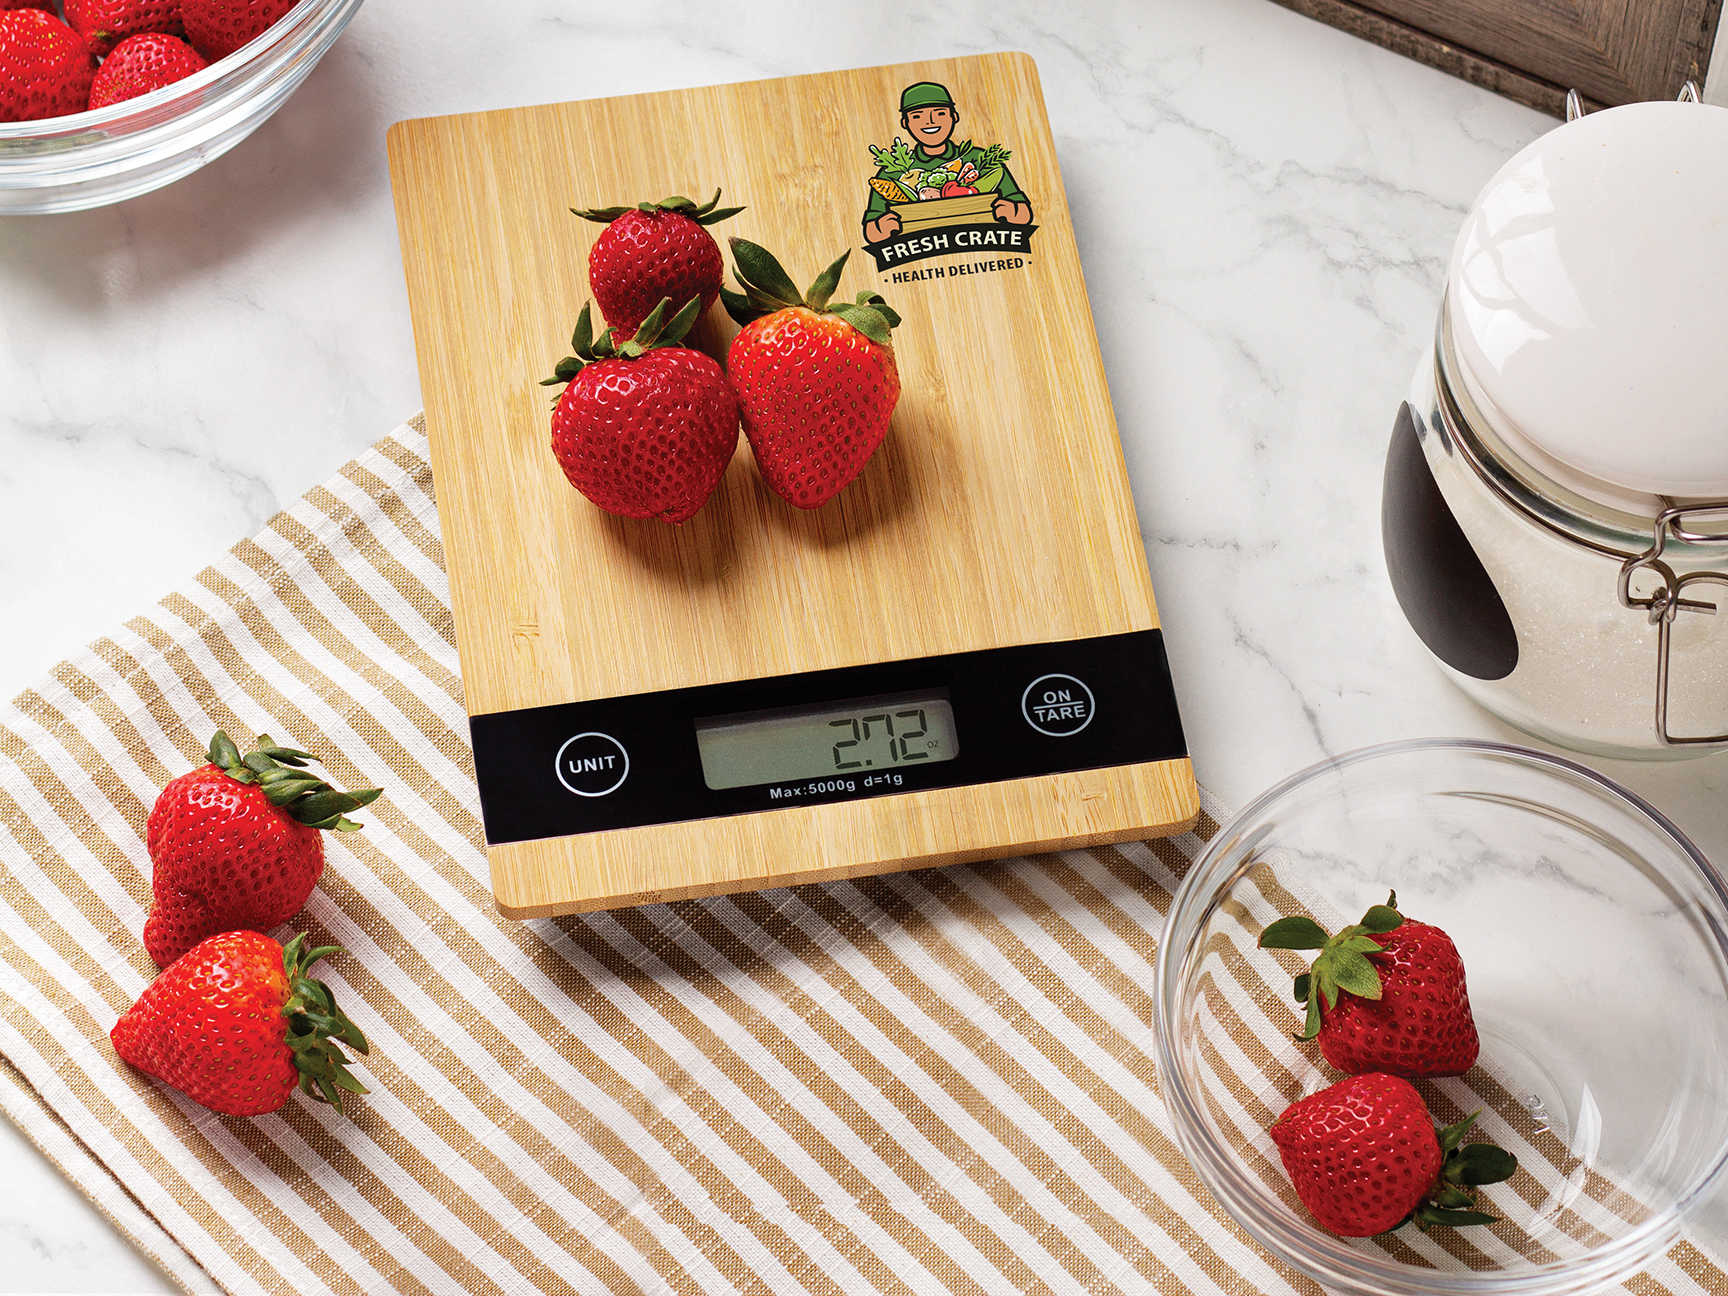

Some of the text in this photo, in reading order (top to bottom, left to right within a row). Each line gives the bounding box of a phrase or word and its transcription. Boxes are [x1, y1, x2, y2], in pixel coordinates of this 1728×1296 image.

[881, 230, 1022, 262] FRESH CRATE
[892, 257, 1024, 283] HEALTH DELIVERED
[1043, 689, 1071, 704] ON
[1034, 705, 1086, 723] TARE
[829, 709, 929, 769] 2.72
[569, 755, 615, 774] UNIT
[769, 773, 903, 799] Max:5000g d=1g
